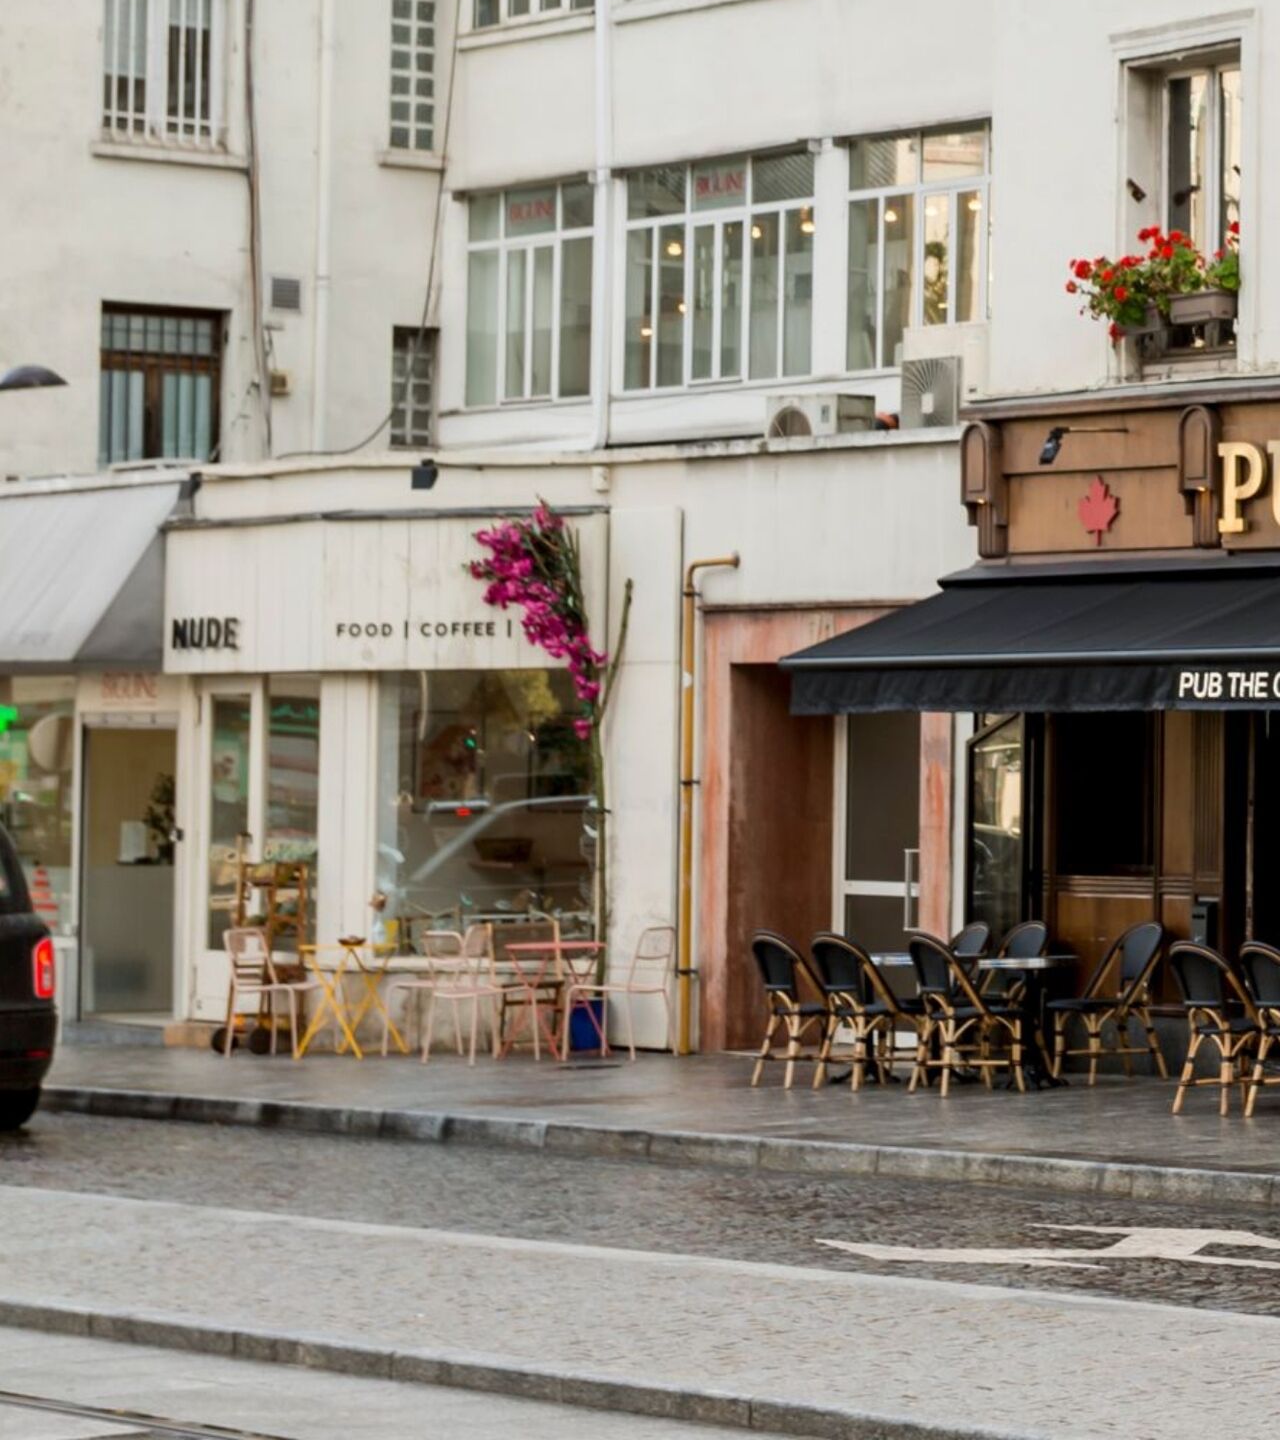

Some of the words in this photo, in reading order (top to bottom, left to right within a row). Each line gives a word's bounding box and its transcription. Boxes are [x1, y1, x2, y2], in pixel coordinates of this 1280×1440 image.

[171, 617, 239, 650] NUDE
[336, 622, 394, 638] FOOD
[419, 620, 496, 637] COFFEE
[1178, 671, 1223, 699] PUB
[1227, 671, 1270, 698] THE
